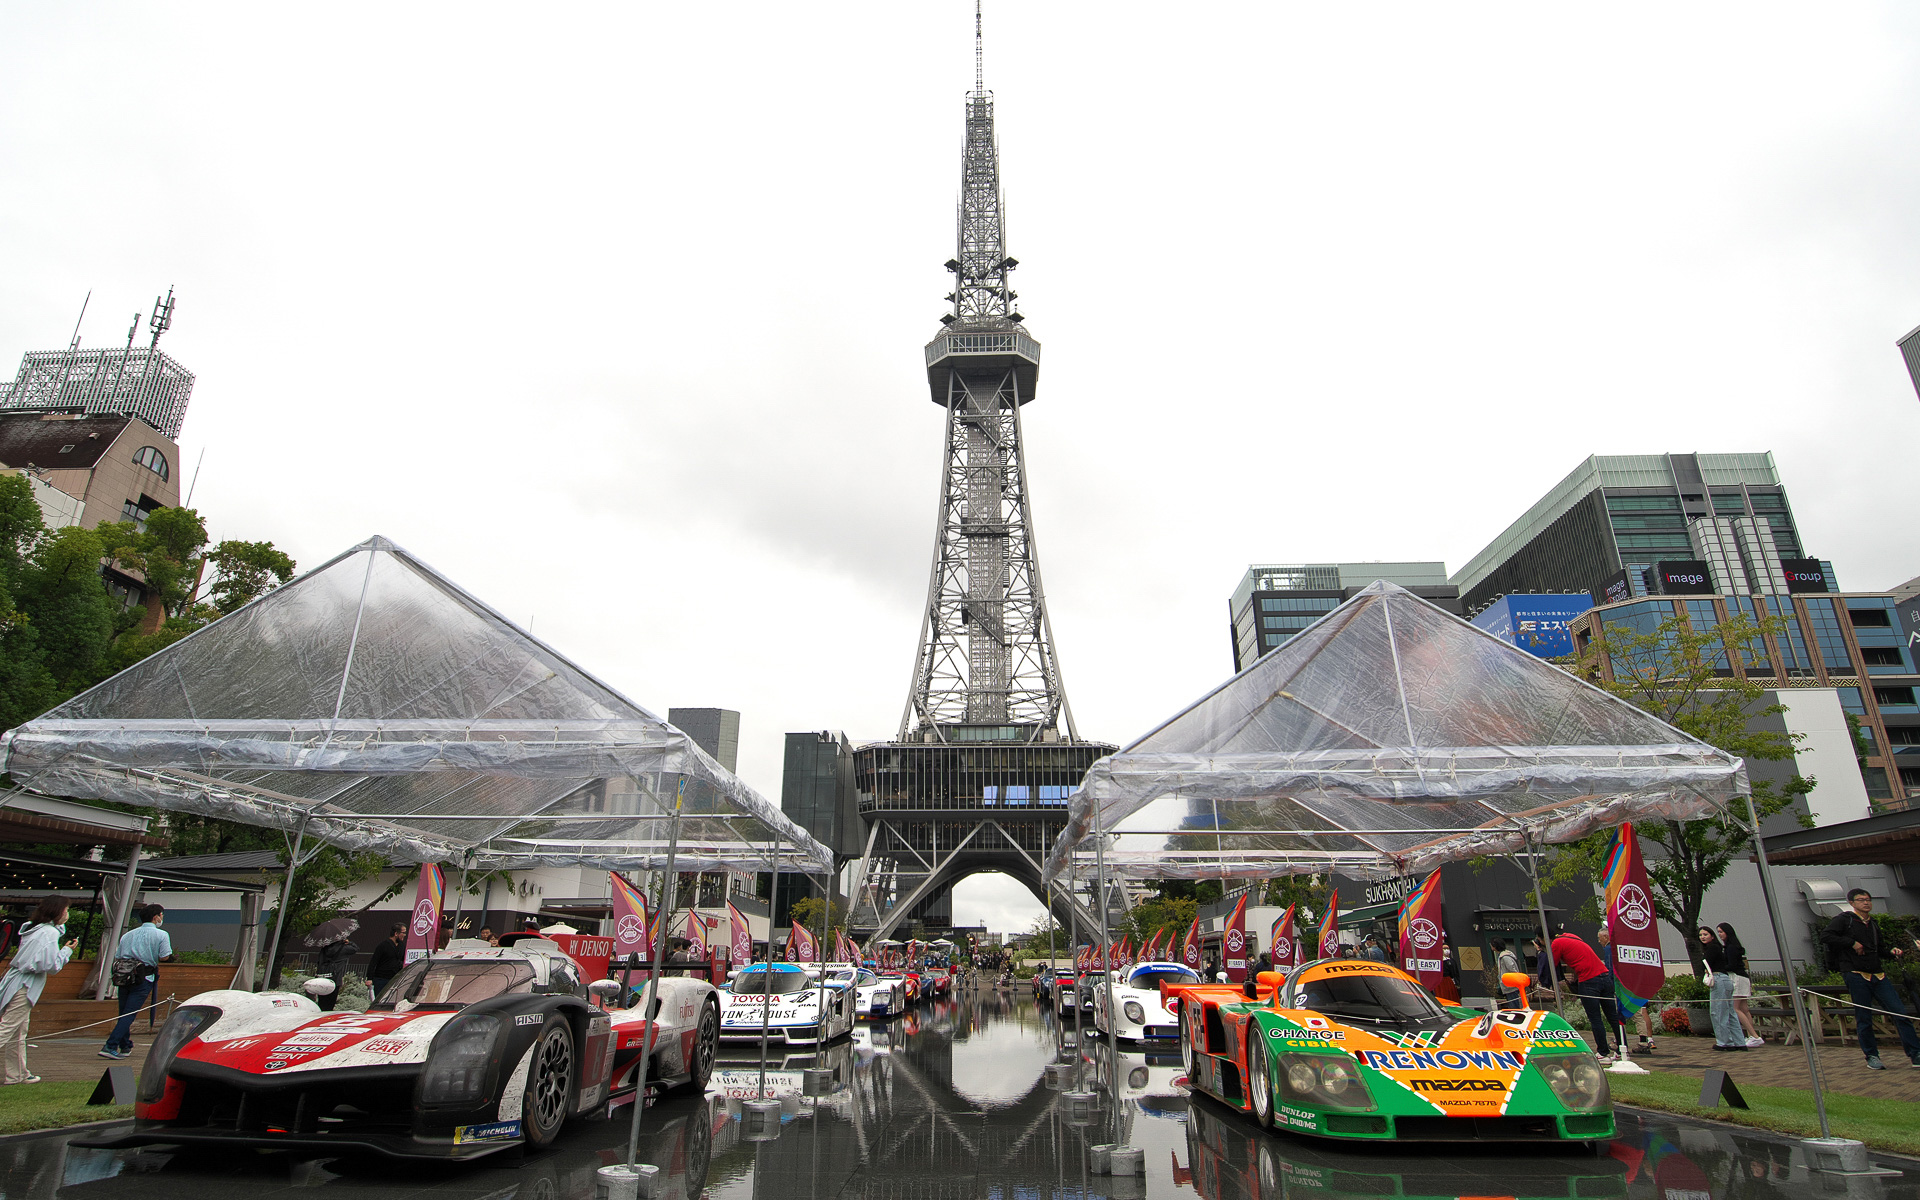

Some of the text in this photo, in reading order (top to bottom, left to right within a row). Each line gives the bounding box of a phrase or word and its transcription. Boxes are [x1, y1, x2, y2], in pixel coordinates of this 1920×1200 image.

[1666, 573, 1703, 585] Image
[1785, 571, 1822, 581] Group
[1604, 579, 1624, 595] Image
[1366, 878, 1417, 903] SUKHONHA
[580, 940, 610, 956] DENSO
[516, 1014, 543, 1026] AISIN
[1269, 1028, 1346, 1040] CHARGE
[1504, 1030, 1582, 1040] CHARGE
[365, 1043, 402, 1054] CAR
[1364, 1050, 1524, 1070] RENOWN
[1282, 1106, 1315, 1120] DUNLOP
[477, 1126, 516, 1136] MICHELIN
